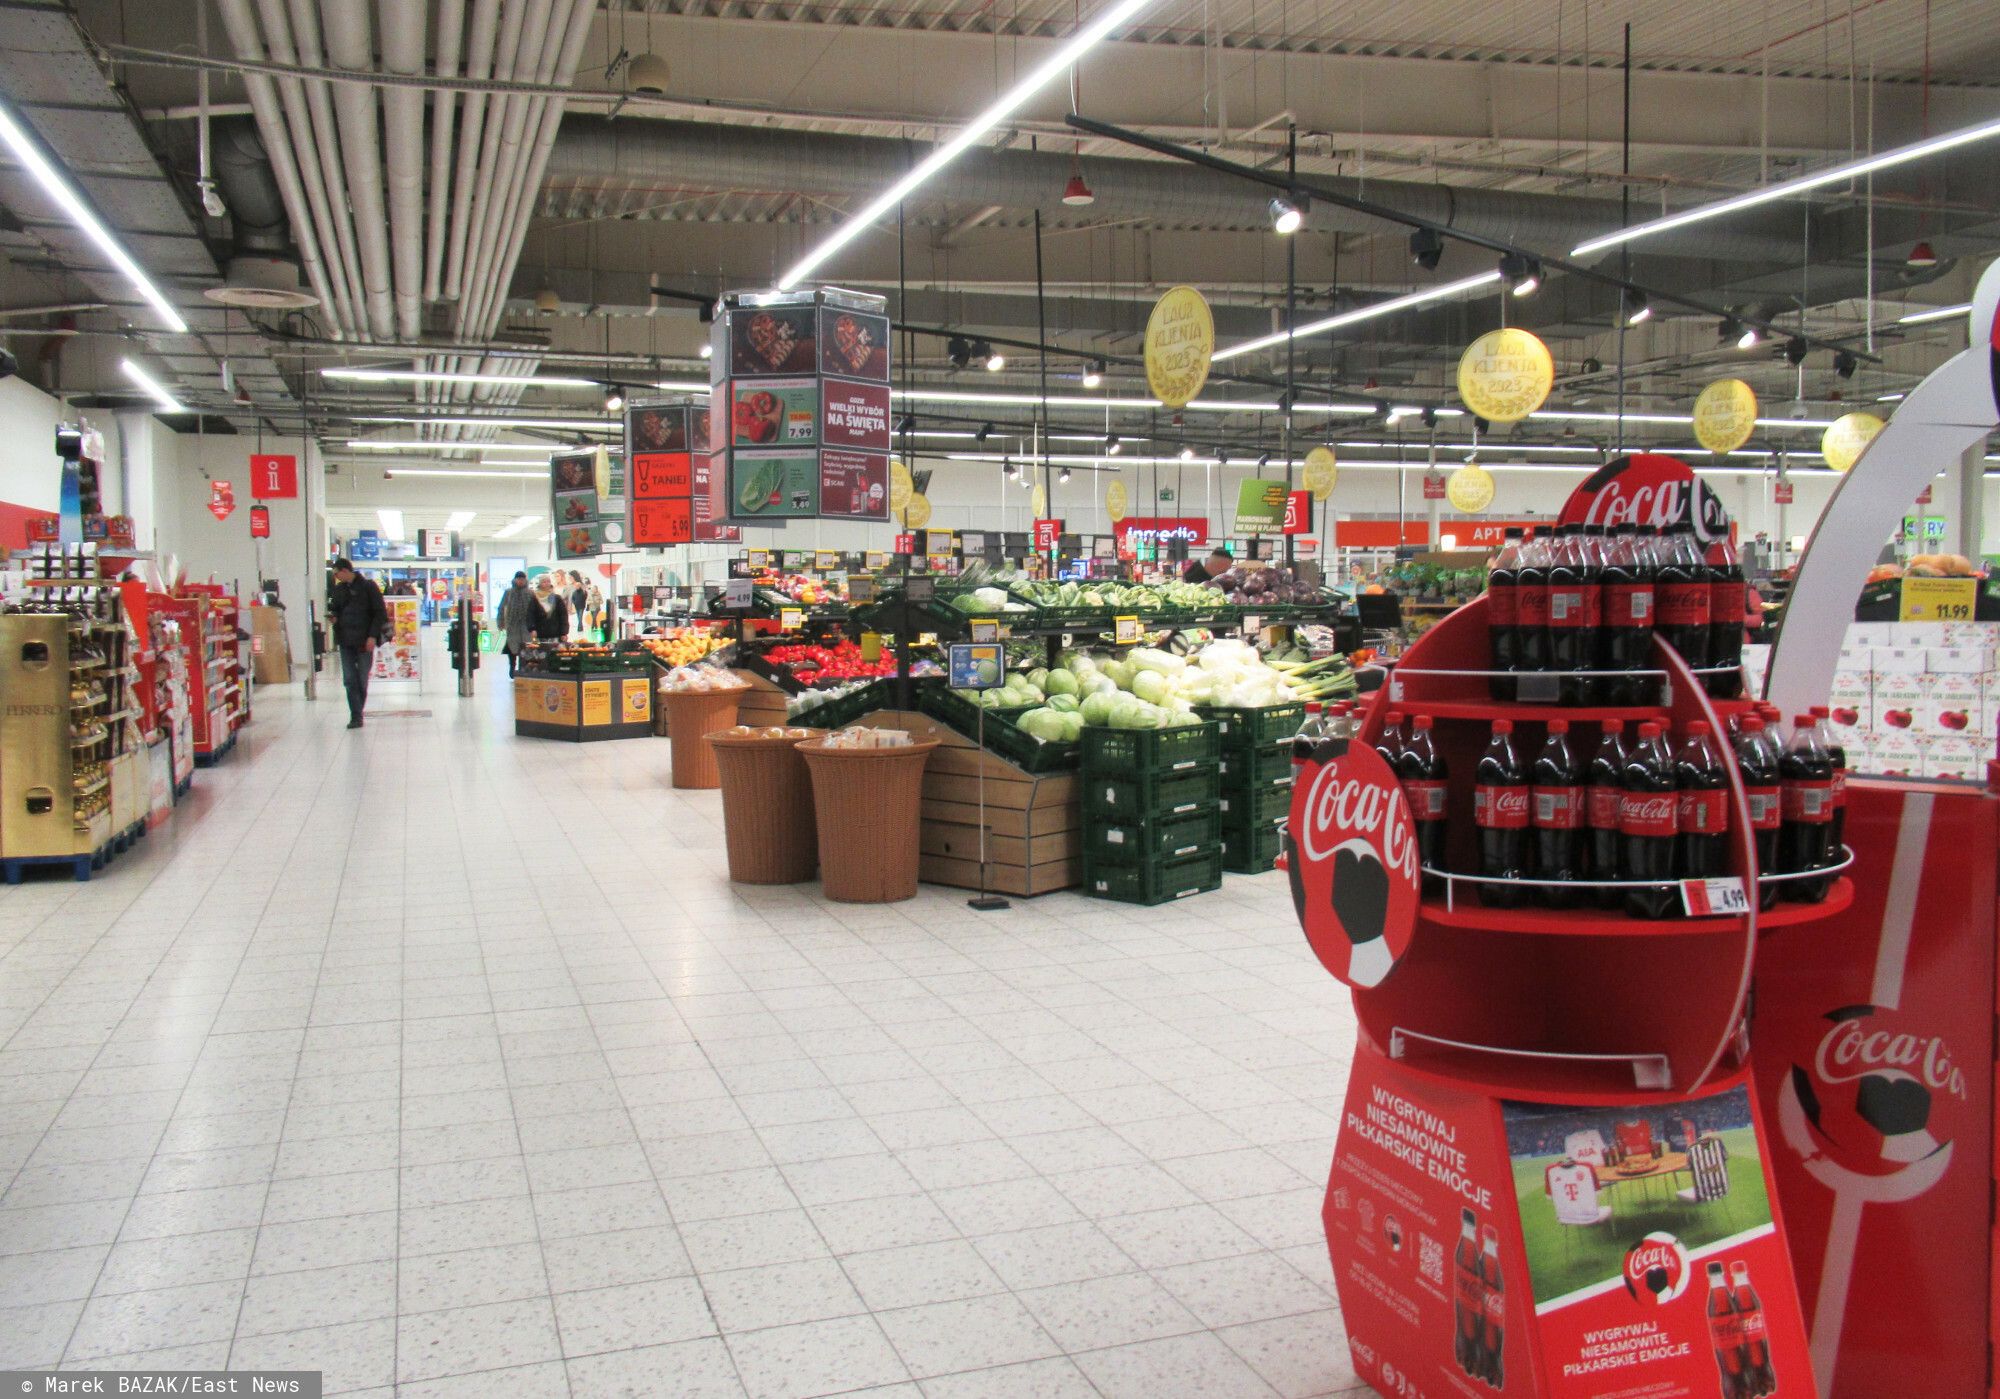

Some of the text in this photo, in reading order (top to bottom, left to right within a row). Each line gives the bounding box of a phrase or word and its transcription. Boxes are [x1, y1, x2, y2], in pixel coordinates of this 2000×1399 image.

[829, 402, 885, 417] WIELKI WYBÓR
[827, 412, 886, 432] NA ŚWIĘTA
[1936, 604, 1969, 618] 11.99
[1722, 888, 1745, 909] 4.99
[1372, 1085, 1456, 1143] WYGRYWAJ
[1367, 1103, 1467, 1173] NIESAMOWITE
[1347, 1113, 1425, 1171] PIŁKARSKIE
[1428, 1158, 1492, 1211] EMOCJE
[1583, 1321, 1658, 1344] WYGRYWAJ
[1580, 1333, 1669, 1359] NIESAMOWITE
[1563, 1342, 1690, 1377] PIŁKARSKIE EMOCJE
